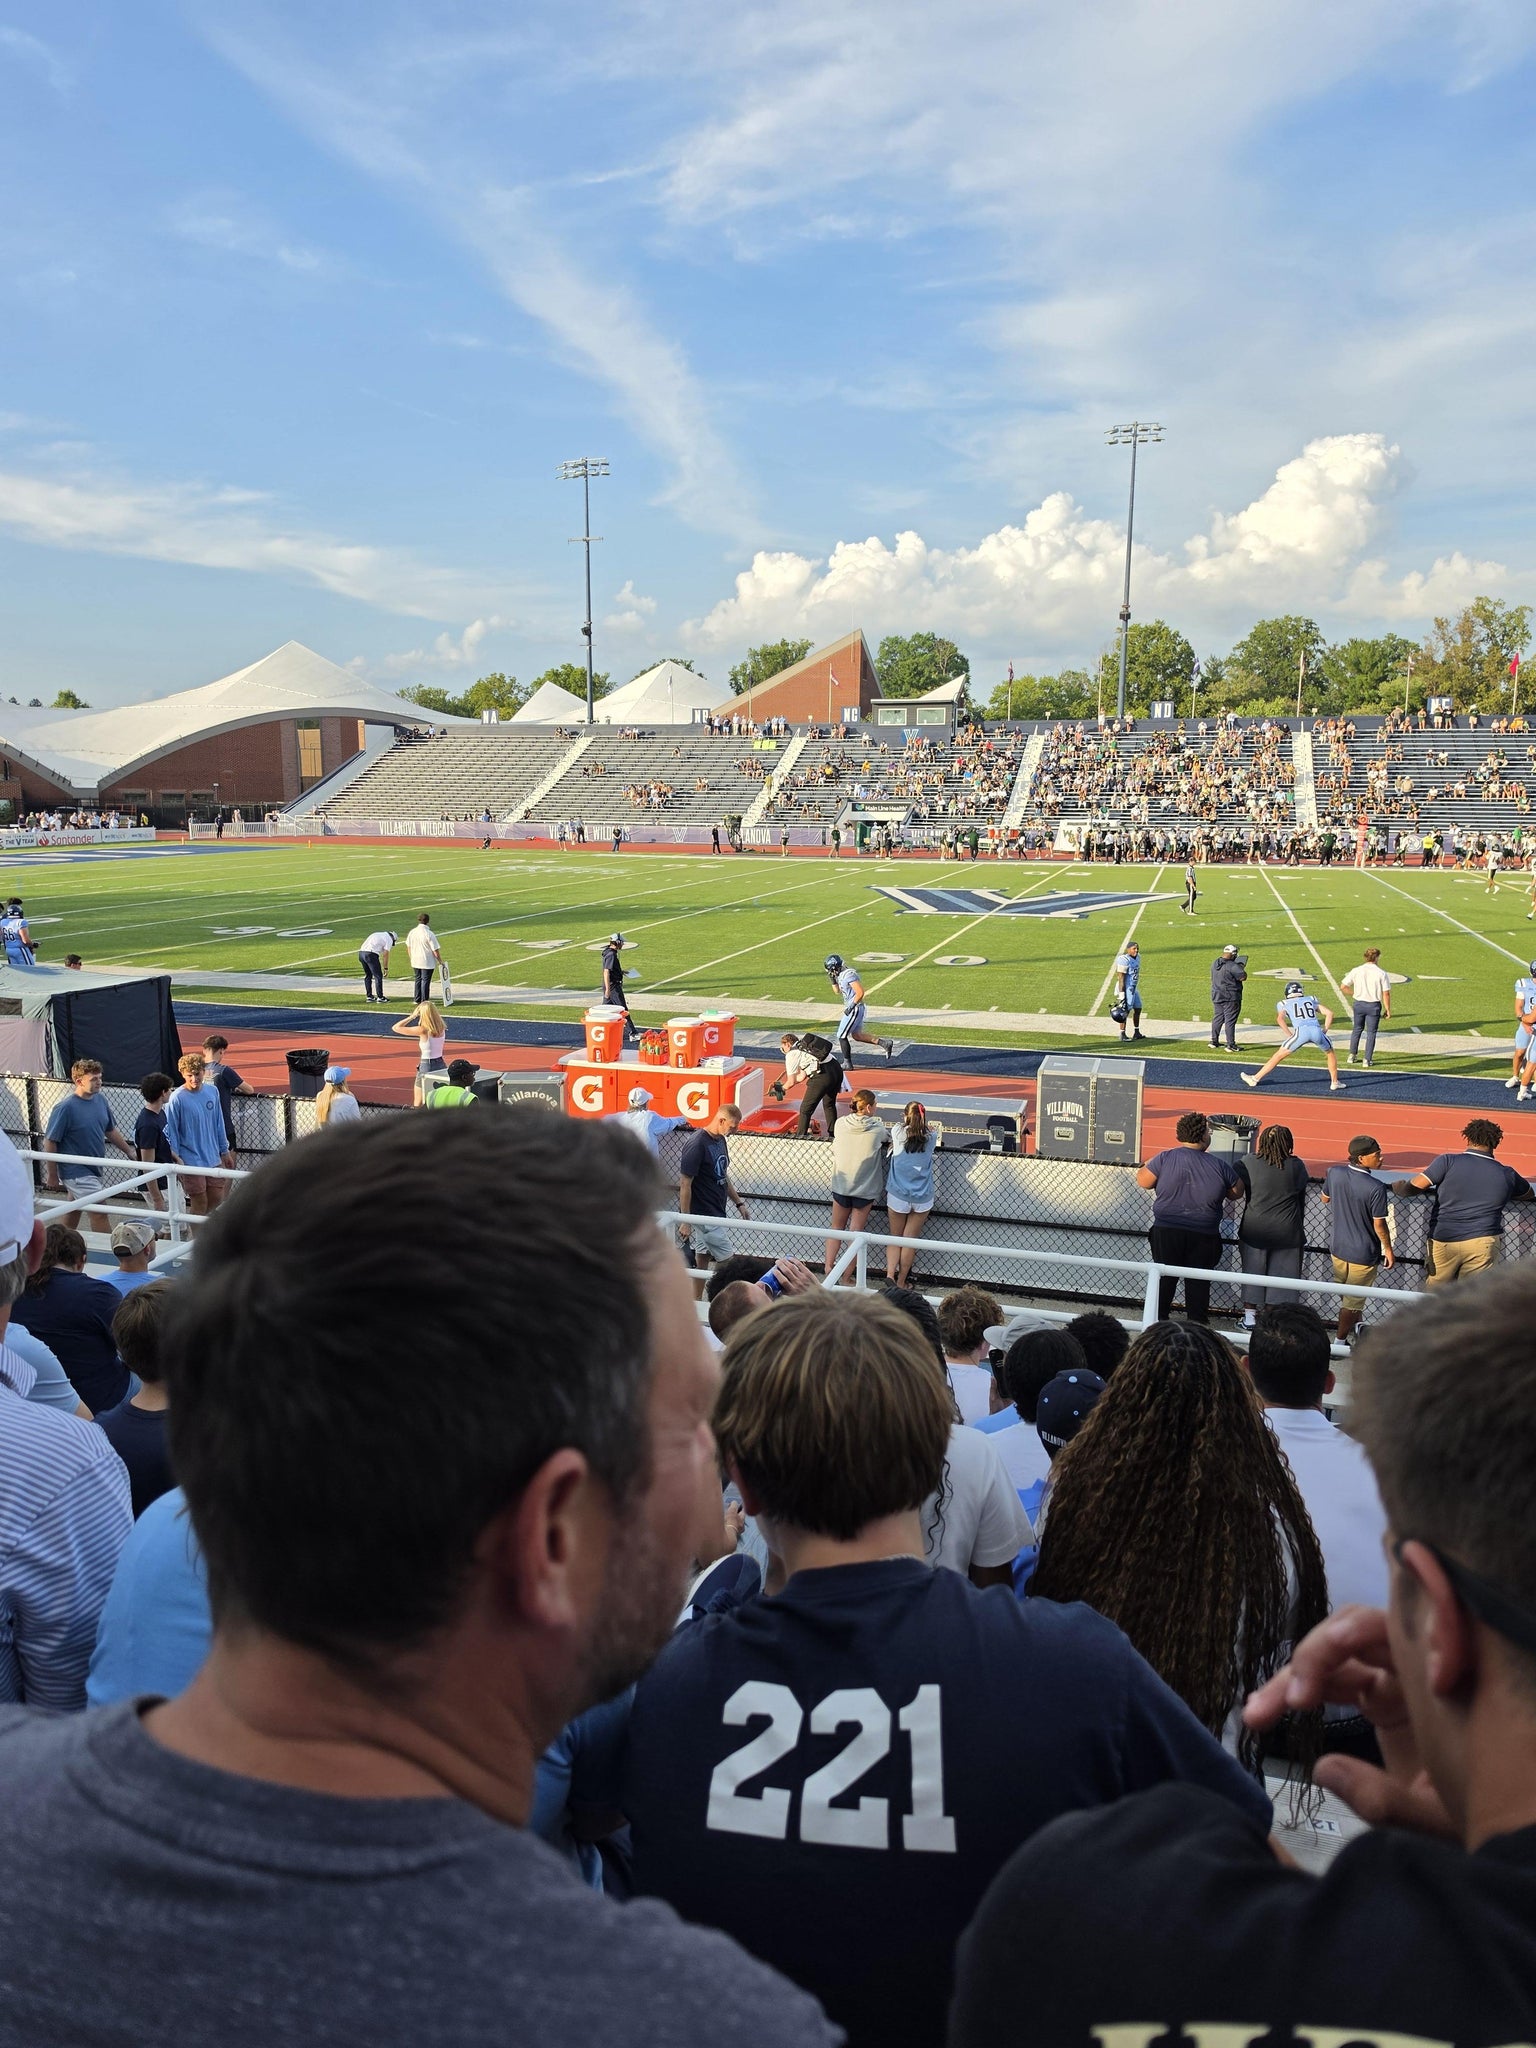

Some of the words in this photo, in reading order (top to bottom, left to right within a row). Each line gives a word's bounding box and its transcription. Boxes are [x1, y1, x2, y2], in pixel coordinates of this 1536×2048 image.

[482, 710, 498, 724] NA
[843, 707, 858, 723] NC
[1153, 702, 1172, 719] ND
[379, 821, 416, 836] VILLANOVA
[420, 821, 455, 837] WILDCATS
[51, 834, 95, 846] Santander
[1294, 1001, 1316, 1020] 46
[591, 1026, 605, 1042] G
[673, 1030, 687, 1047] G
[704, 1026, 719, 1044] G
[571, 1075, 604, 1112] G
[676, 1082, 710, 1120] G
[1046, 1101, 1085, 1119] VILLANOVA
[1052, 1115, 1079, 1123] FOOTBALL
[706, 1679, 957, 1853] 221
